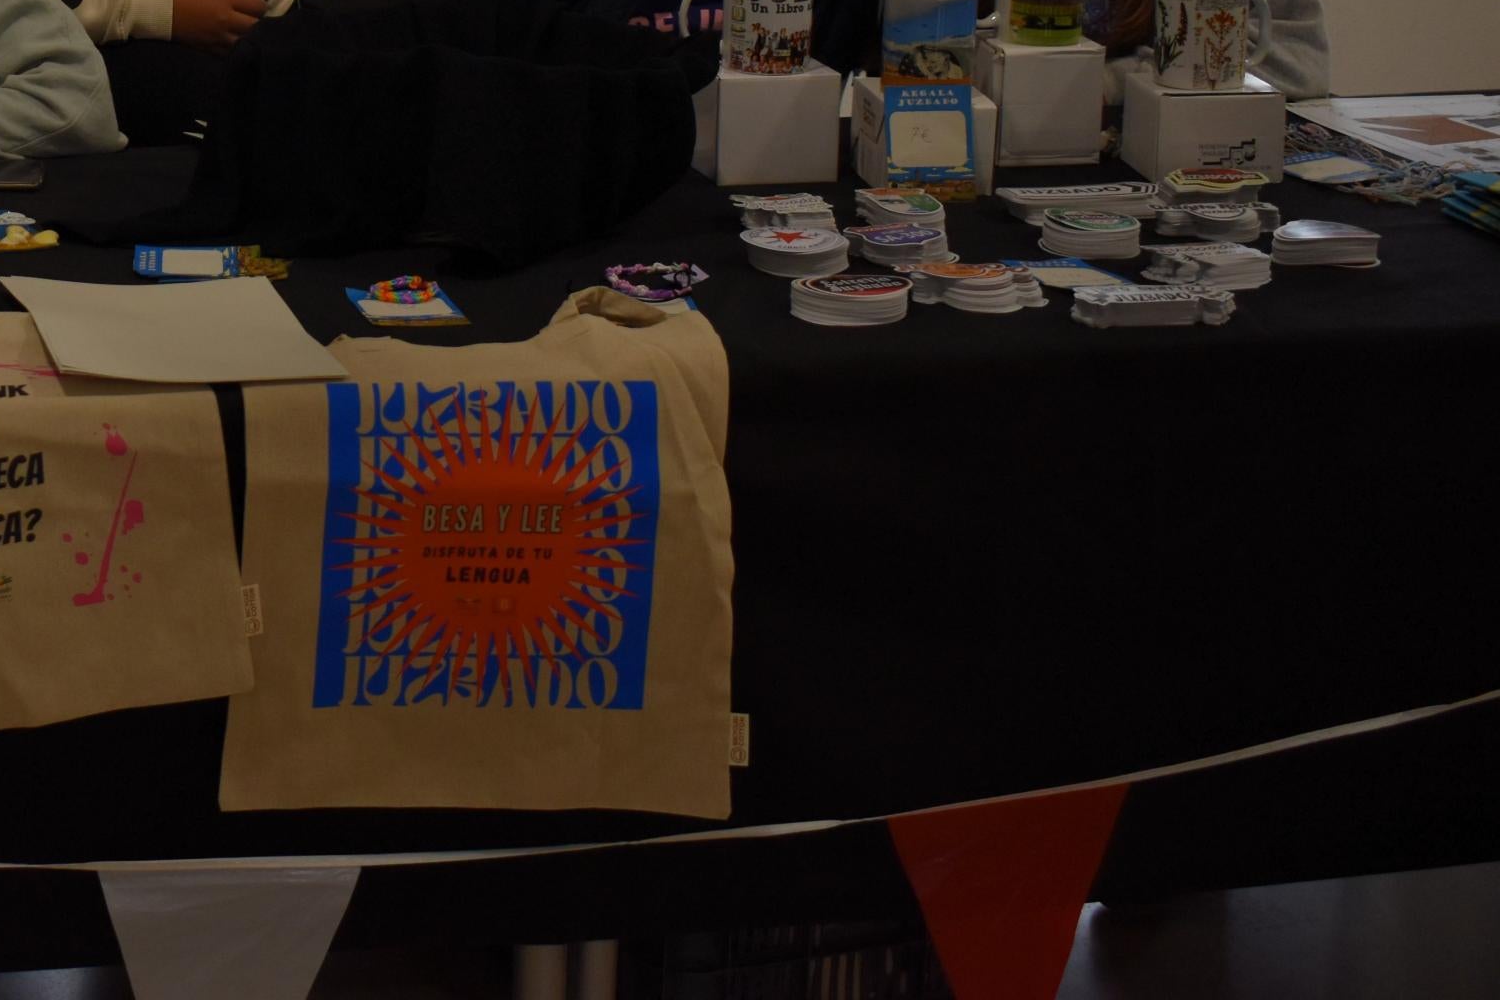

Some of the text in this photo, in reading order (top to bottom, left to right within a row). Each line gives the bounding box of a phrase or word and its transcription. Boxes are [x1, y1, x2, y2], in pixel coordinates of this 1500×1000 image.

[901, 88, 955, 97] REGALA
[897, 98, 959, 107] JUZBADO
[1019, 185, 1121, 195] JUZBADO
[422, 503, 563, 533] BESA Y LEE
[422, 545, 554, 560] DISFRUTA DE TU
[445, 566, 531, 585] LENGUA
